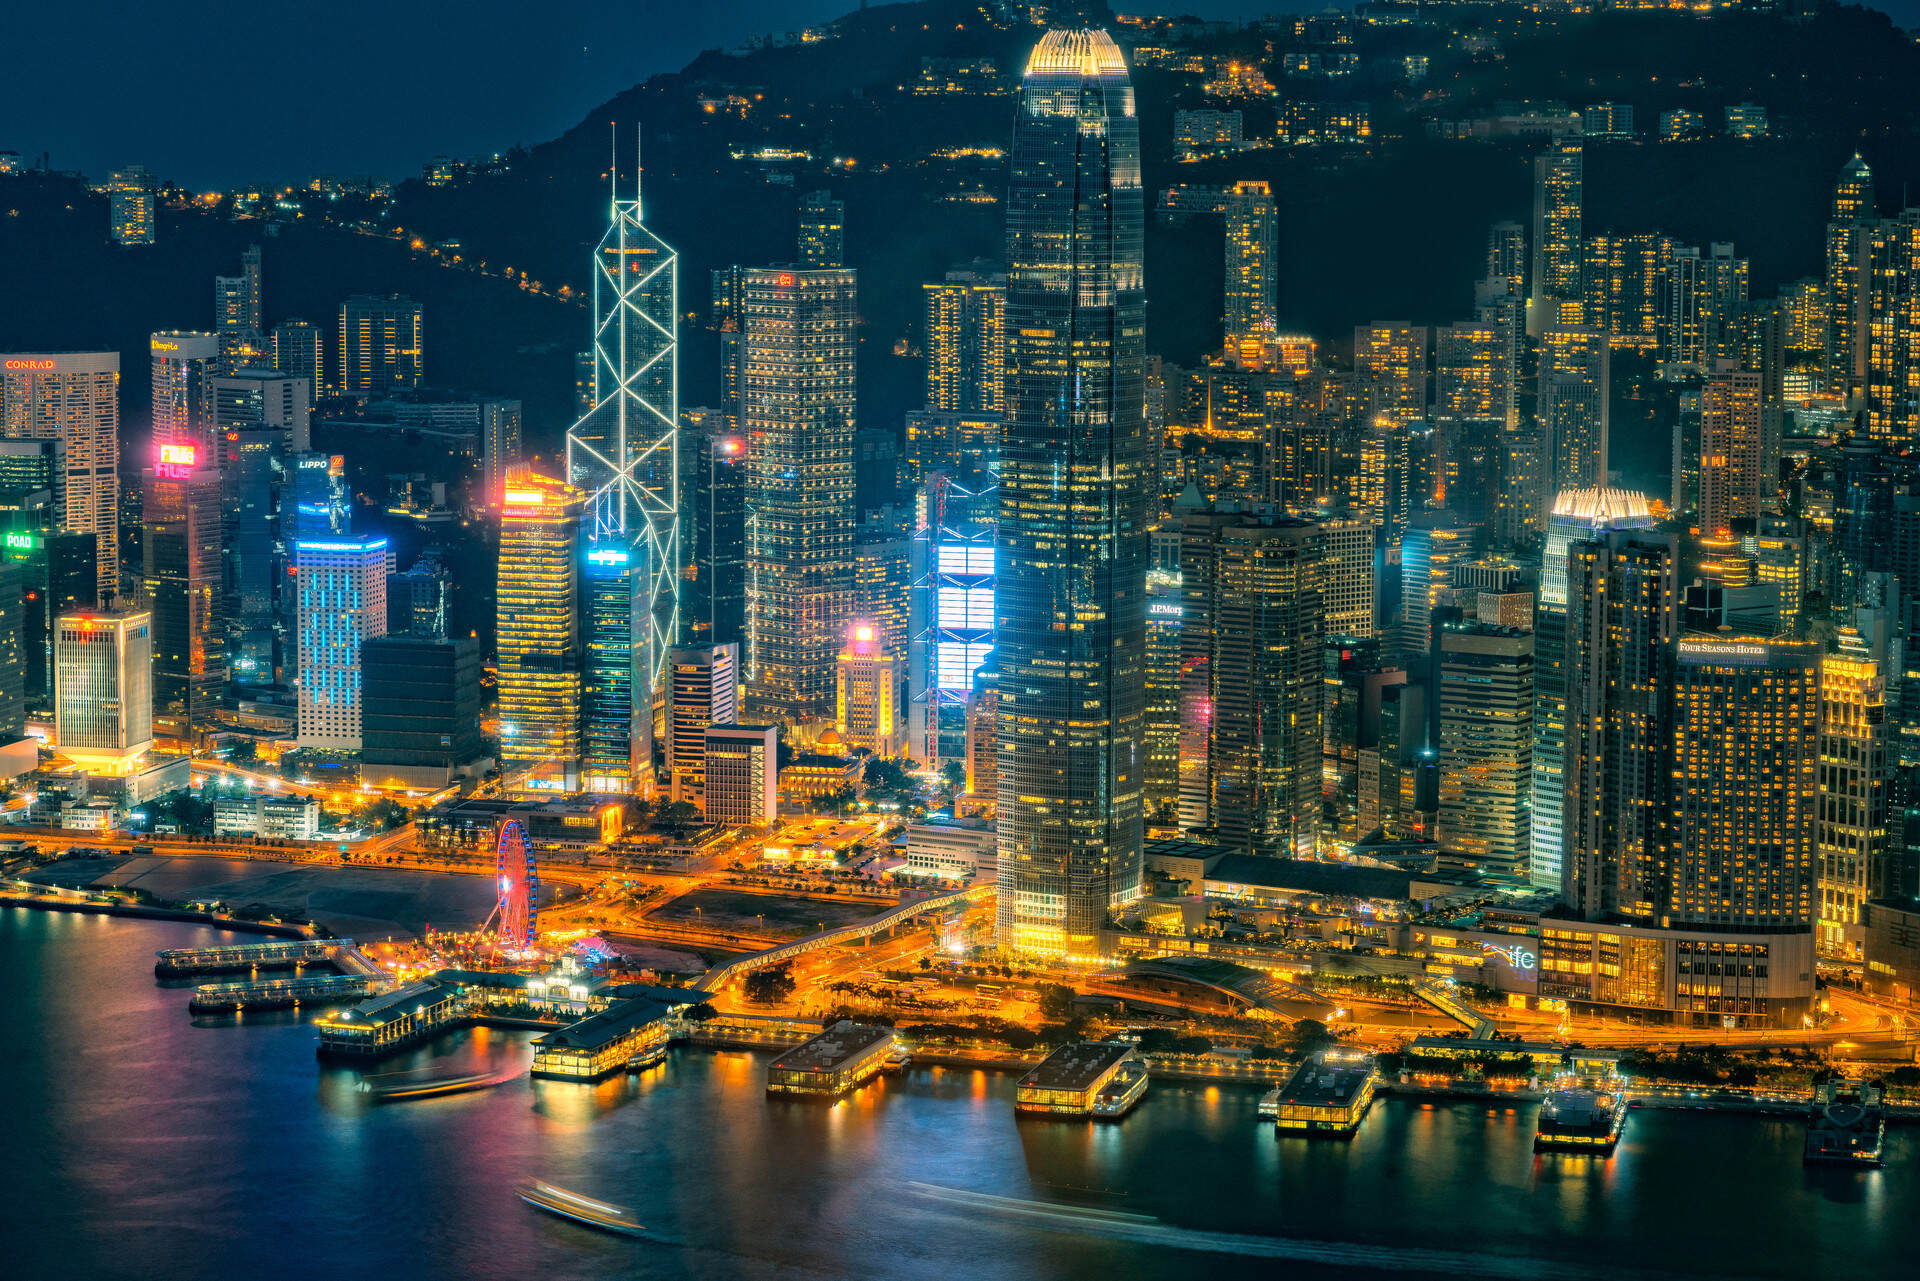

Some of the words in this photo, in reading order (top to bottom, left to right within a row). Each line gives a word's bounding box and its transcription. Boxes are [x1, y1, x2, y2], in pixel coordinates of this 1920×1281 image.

[5, 360, 55, 369] CONRAD
[299, 461, 327, 469] LIPPO
[7, 534, 32, 548] POAD
[1680, 643, 1701, 652] FOUR
[1702, 644, 1735, 653] SEASONS
[1736, 645, 1765, 654] HOTEL
[1509, 945, 1535, 969] ifc
